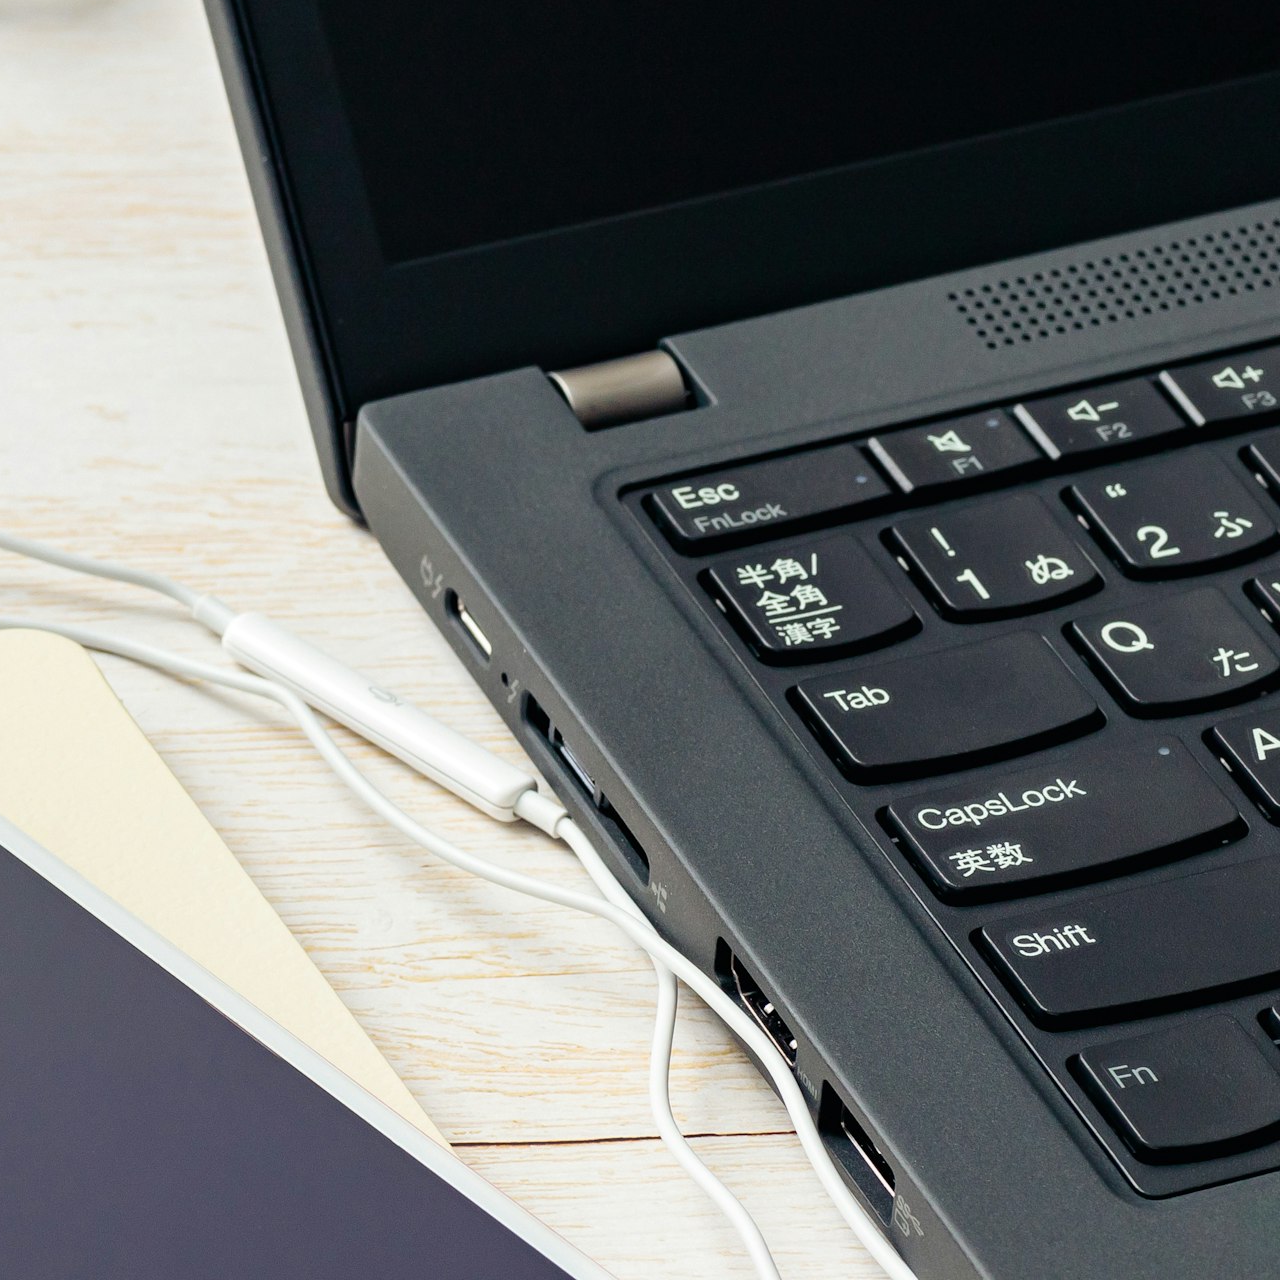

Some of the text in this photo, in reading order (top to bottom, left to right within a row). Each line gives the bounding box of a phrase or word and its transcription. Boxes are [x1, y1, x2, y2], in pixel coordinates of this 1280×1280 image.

[1241, 390, 1278, 410] F3
[1096, 420, 1133, 441] F2
[952, 455, 984, 475] F1
[671, 482, 740, 510] Esc
[693, 503, 788, 534] FnLock
[931, 527, 956, 558] !
[1137, 511, 1253, 559] 2 ふ
[737, 552, 820, 589] 半角/
[956, 554, 1074, 600] 1 ぬ
[756, 583, 828, 616] 全角
[776, 618, 841, 647] 漢字
[1101, 621, 1155, 653] Q
[1212, 647, 1260, 677] た
[823, 685, 891, 713] Tab
[1252, 727, 1280, 761] A
[917, 777, 1088, 831] CapsLock
[949, 842, 1034, 877] 英数
[1012, 924, 1097, 958] Shift
[1107, 1063, 1160, 1091] Fn
